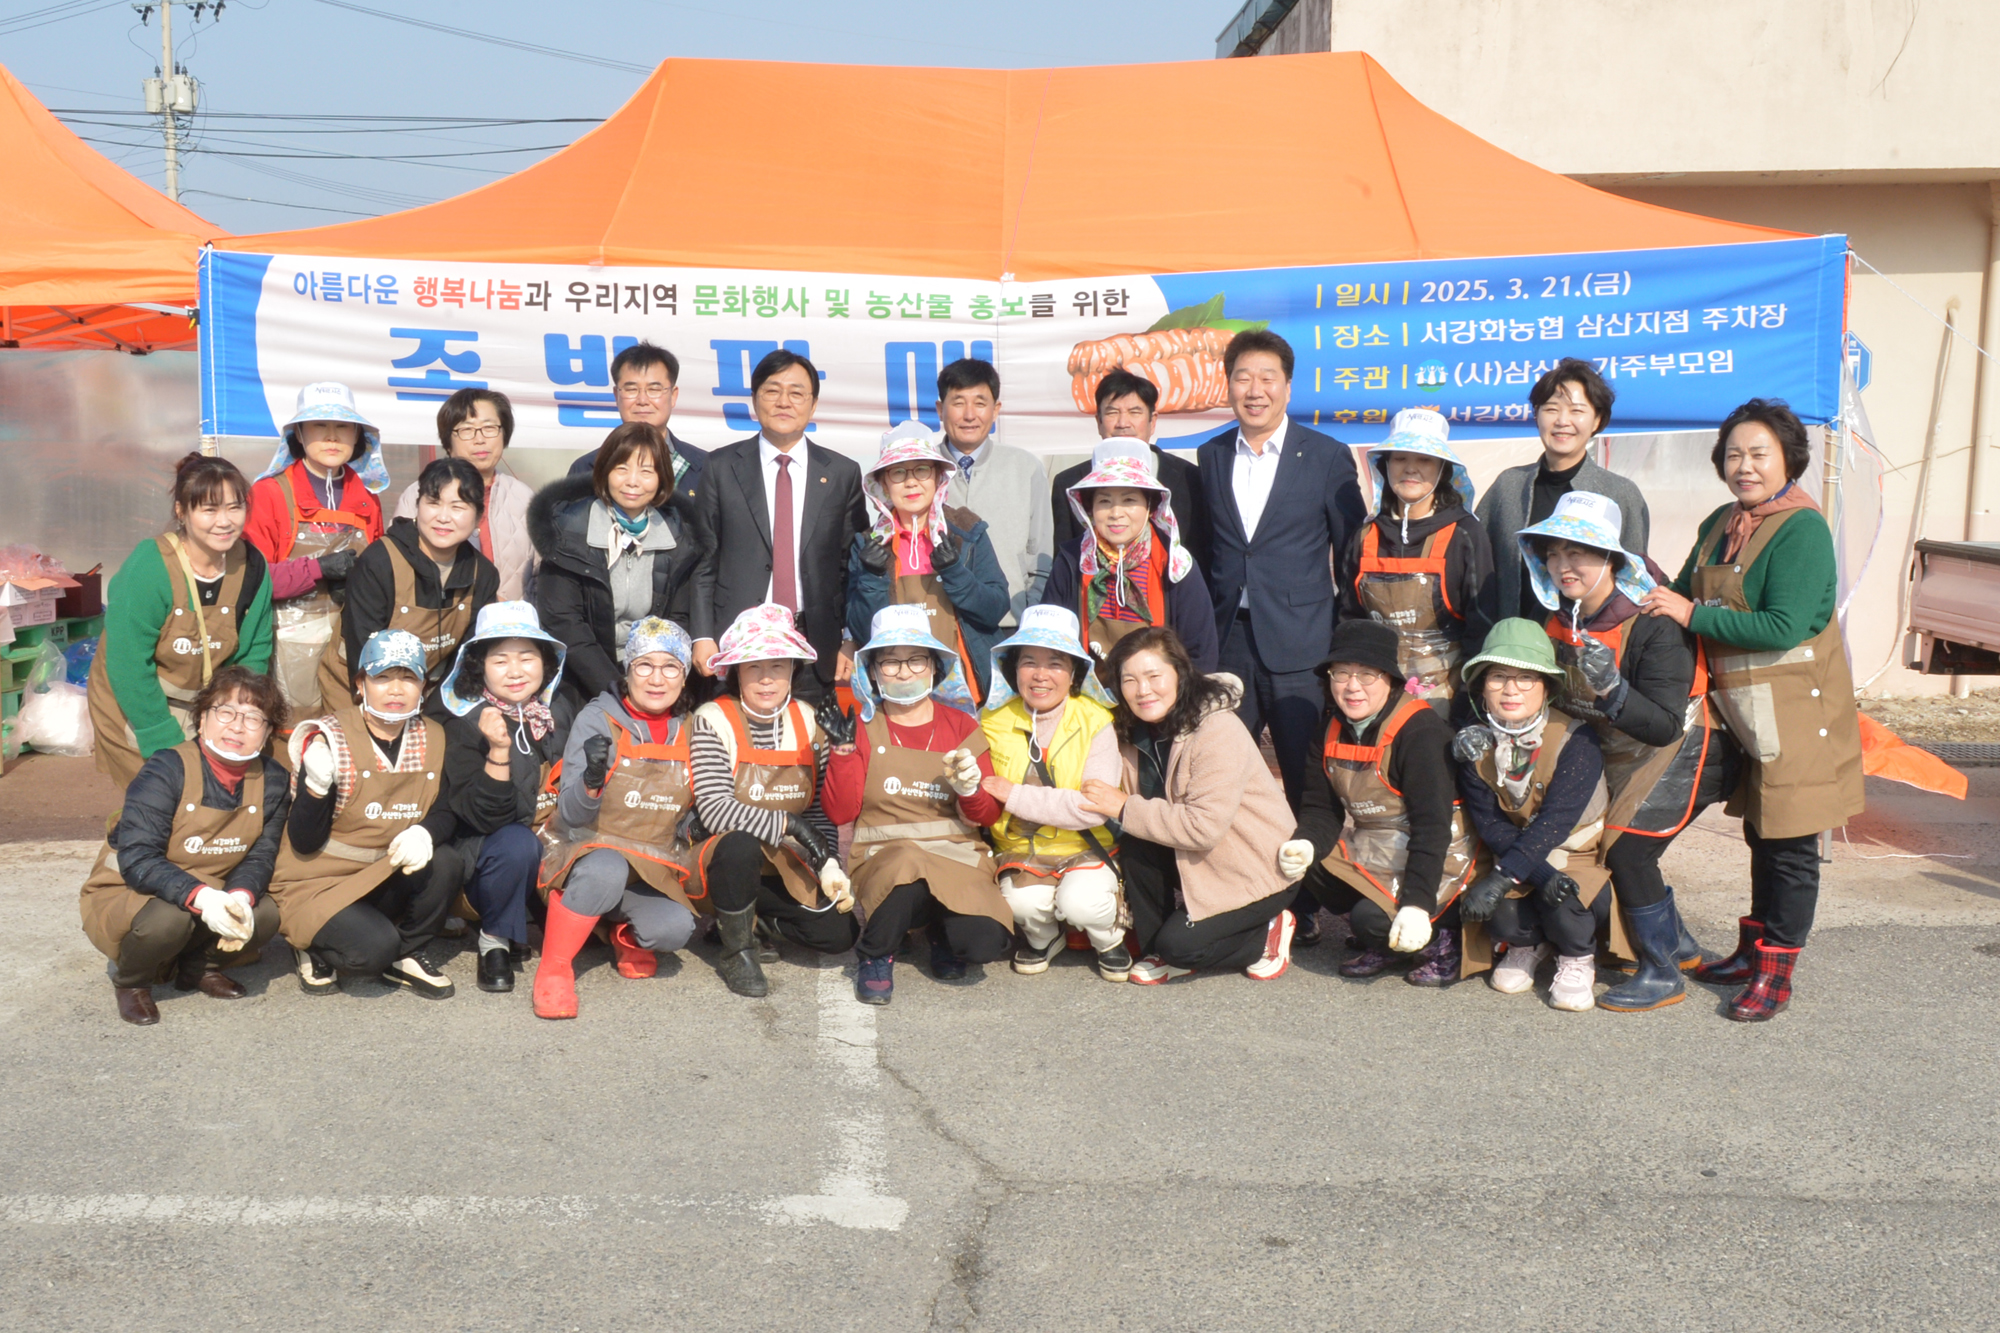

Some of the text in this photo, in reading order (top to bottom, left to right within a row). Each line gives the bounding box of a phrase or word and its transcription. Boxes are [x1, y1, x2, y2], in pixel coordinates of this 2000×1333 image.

[293, 270, 1131, 320] 아름다운 행복나눔과 우리지역 문화행사 및 농산물 홍보를 위한
[1335, 282, 1390, 307] 일시
[1419, 279, 1495, 303] 2025.
[1505, 277, 1529, 300] 3.
[1332, 303, 1788, 349] 장소 서강화농협 삼산지점 주차장
[1333, 349, 1734, 390] 주관 (사)삼산가주부모임
[1333, 408, 1388, 424] 후원
[1449, 403, 1533, 423] 서강화
[51, 625, 65, 637] KPP
